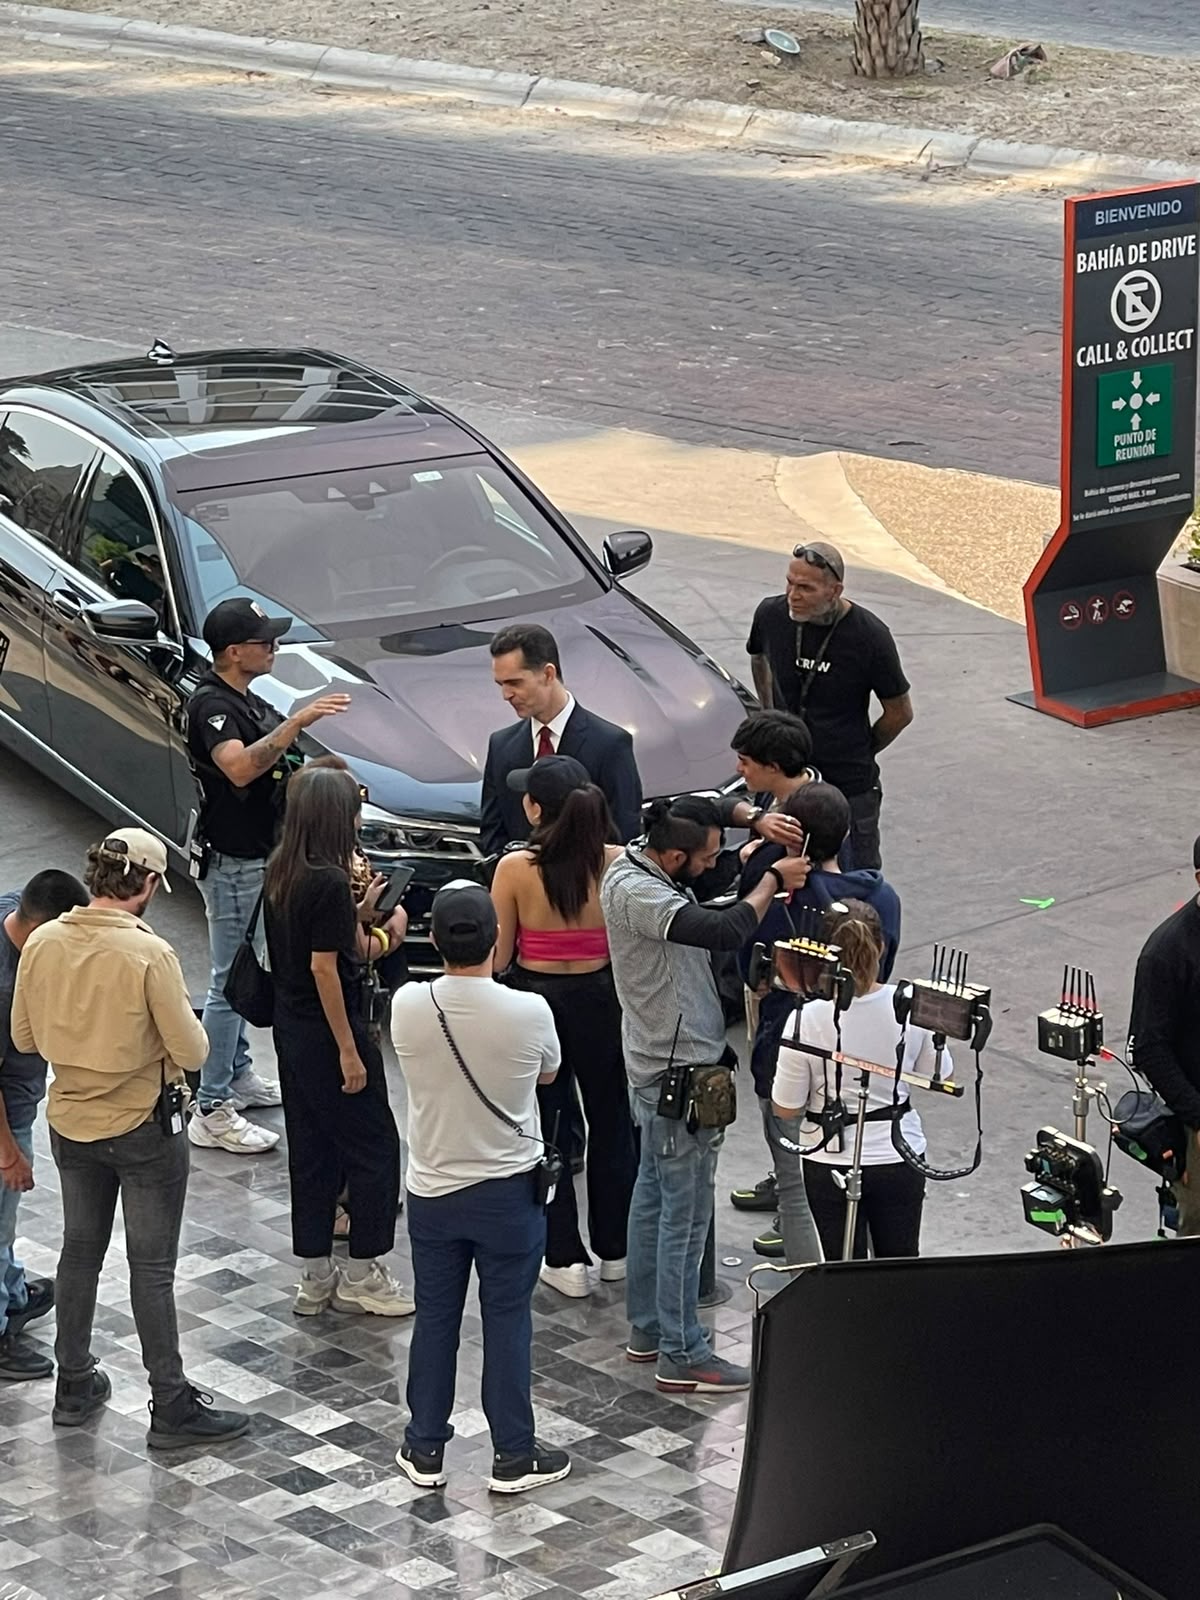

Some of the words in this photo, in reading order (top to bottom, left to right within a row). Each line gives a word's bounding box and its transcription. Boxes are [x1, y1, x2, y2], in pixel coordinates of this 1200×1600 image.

[1095, 199, 1182, 226] BIENVENIDO
[1076, 243, 1125, 274] BAHÍA
[1127, 242, 1148, 265] DE
[1151, 234, 1197, 262] DRIVE
[1076, 342, 1113, 367] CALL
[1116, 340, 1128, 360] &
[1131, 328, 1194, 359] COLLECT
[1113, 430, 1144, 447] PUNTO
[1145, 428, 1157, 441] DE
[1115, 443, 1155, 461] REUNIÓN
